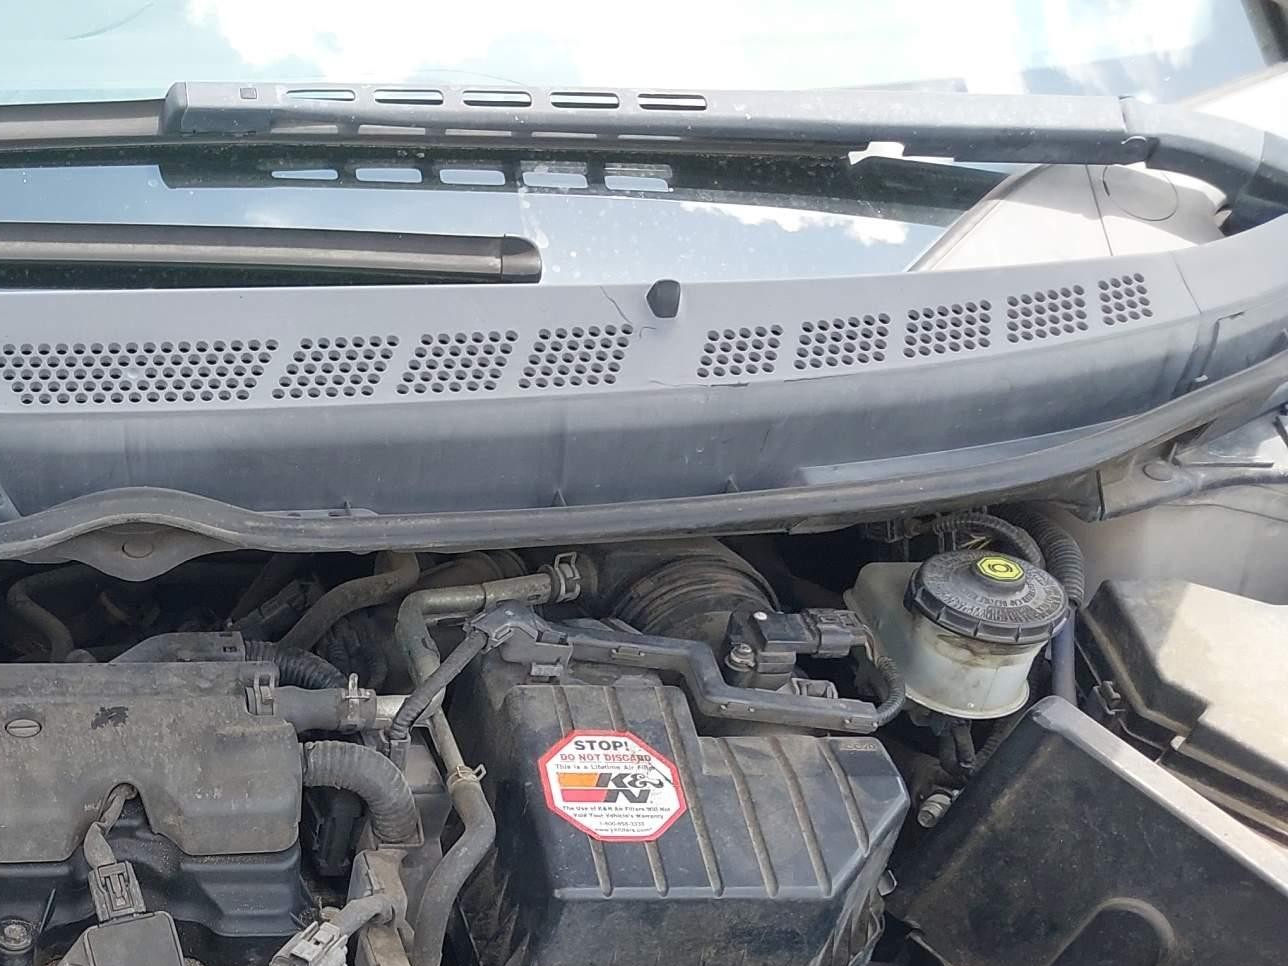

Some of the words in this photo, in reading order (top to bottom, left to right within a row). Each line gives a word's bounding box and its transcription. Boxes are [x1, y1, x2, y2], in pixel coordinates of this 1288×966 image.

[574, 740, 630, 752] STOP!
[560, 753, 575, 761] DO
[578, 753, 600, 761] NOT
[604, 753, 651, 762] DISCARD
